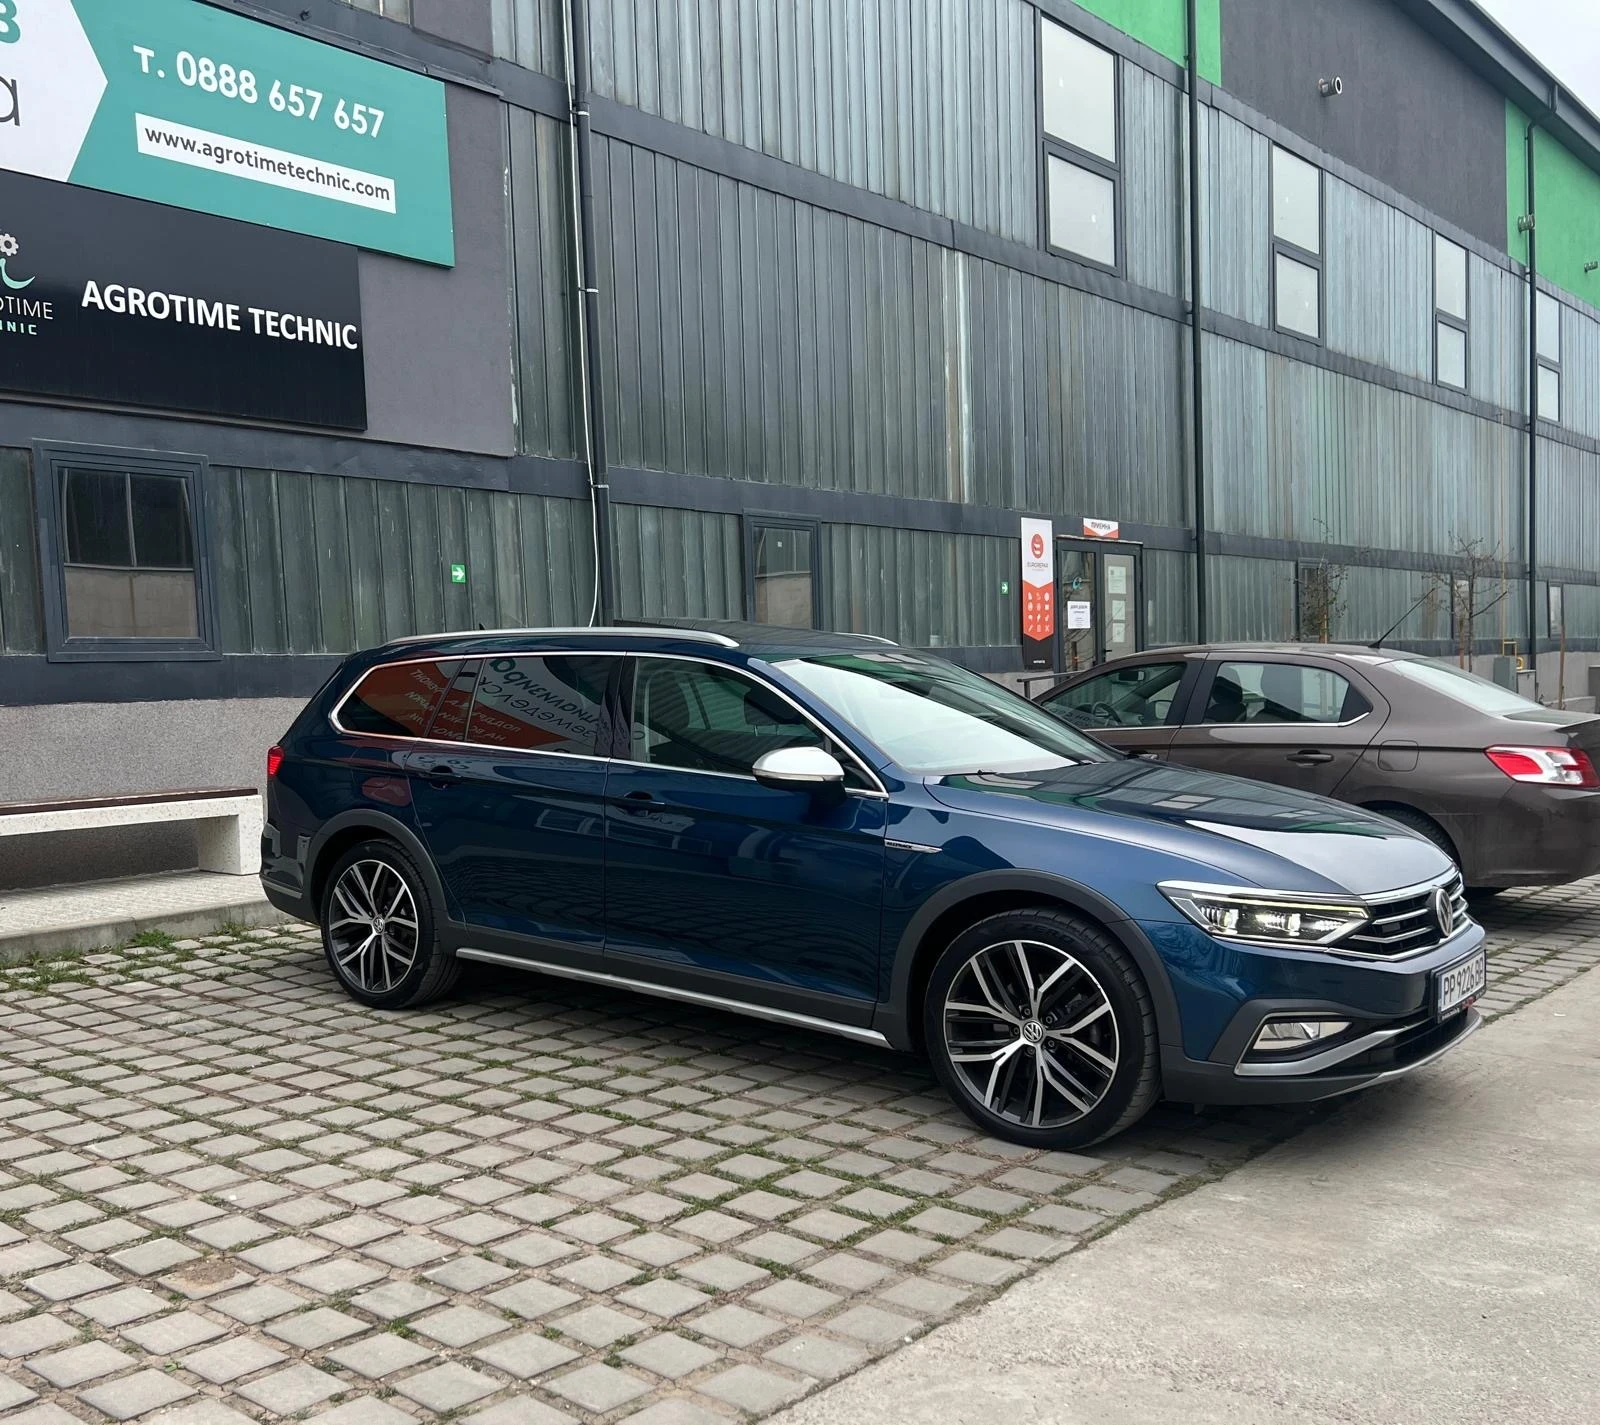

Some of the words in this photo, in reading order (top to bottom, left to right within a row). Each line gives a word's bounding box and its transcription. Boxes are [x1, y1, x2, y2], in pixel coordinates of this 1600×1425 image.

[176, 50, 259, 104] 0888
[268, 79, 323, 122] 657
[333, 98, 386, 139] 657
[144, 126, 391, 201] www.agrotimetechnic.com
[81, 279, 241, 332] AGROTIME
[248, 306, 358, 350] TECHNIC
[1443, 973, 1456, 1006] PP
[1456, 962, 1475, 999] 9226
